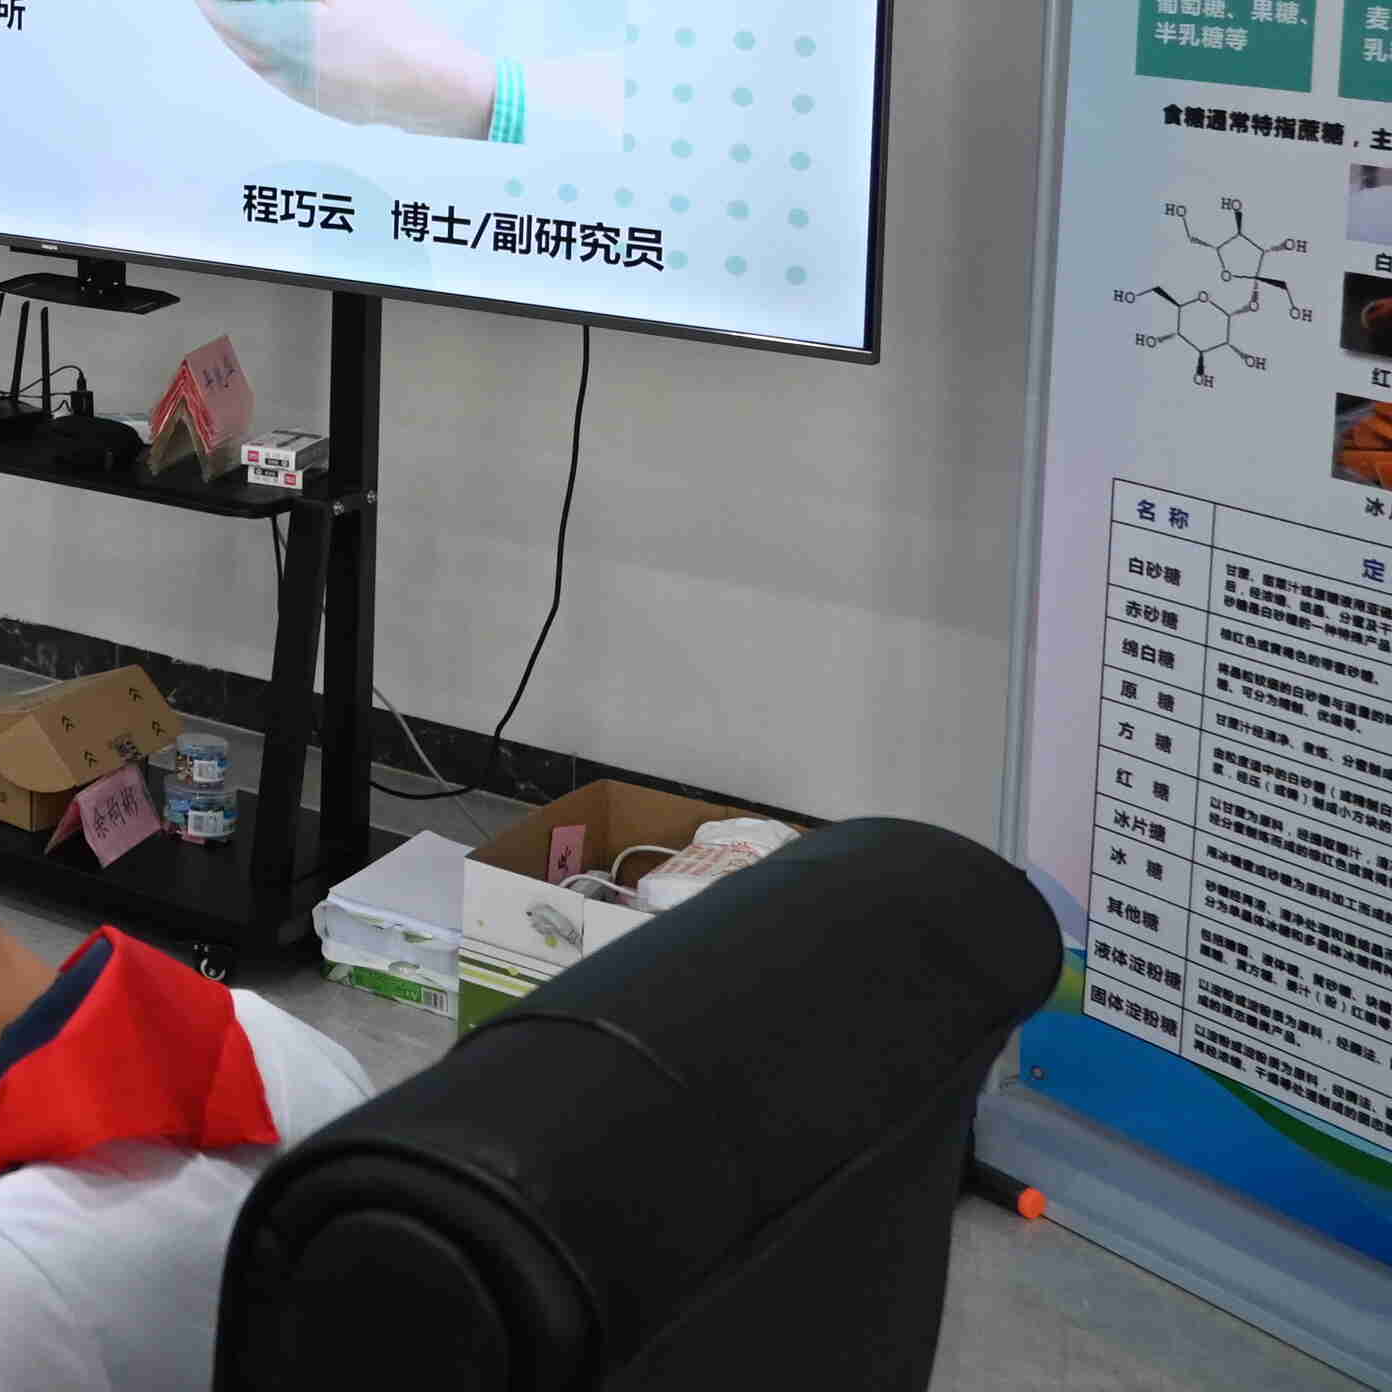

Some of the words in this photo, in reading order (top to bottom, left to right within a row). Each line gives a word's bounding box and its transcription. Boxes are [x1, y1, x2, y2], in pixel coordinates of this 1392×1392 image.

[1154, 21, 1249, 51] 半乳糖等
[242, 181, 358, 240] 程巧云
[390, 199, 668, 273] 博士/副研究员
[1127, 556, 1182, 587] 白砂糖
